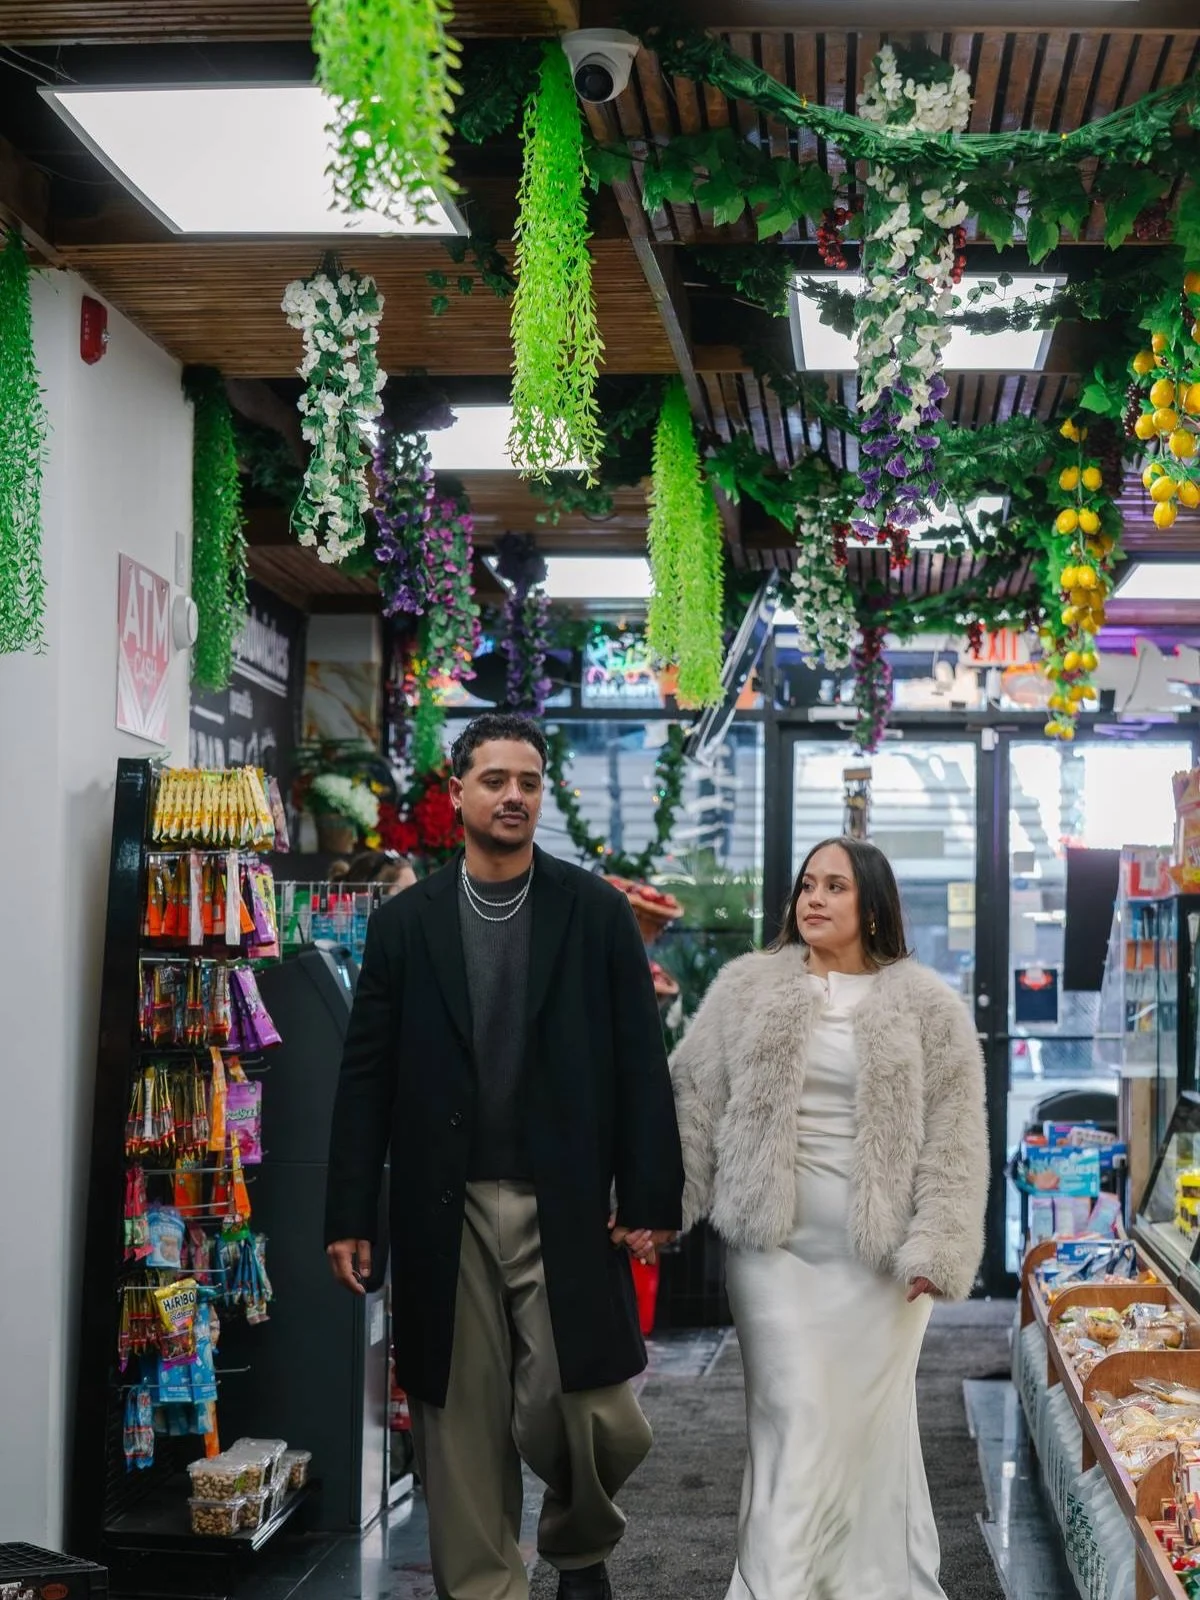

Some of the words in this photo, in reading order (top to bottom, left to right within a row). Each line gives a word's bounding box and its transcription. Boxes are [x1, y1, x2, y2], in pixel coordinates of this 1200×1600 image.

[123, 565, 169, 663] ATM
[972, 626, 1019, 662] XIT
[163, 1291, 195, 1312] HARIBO
